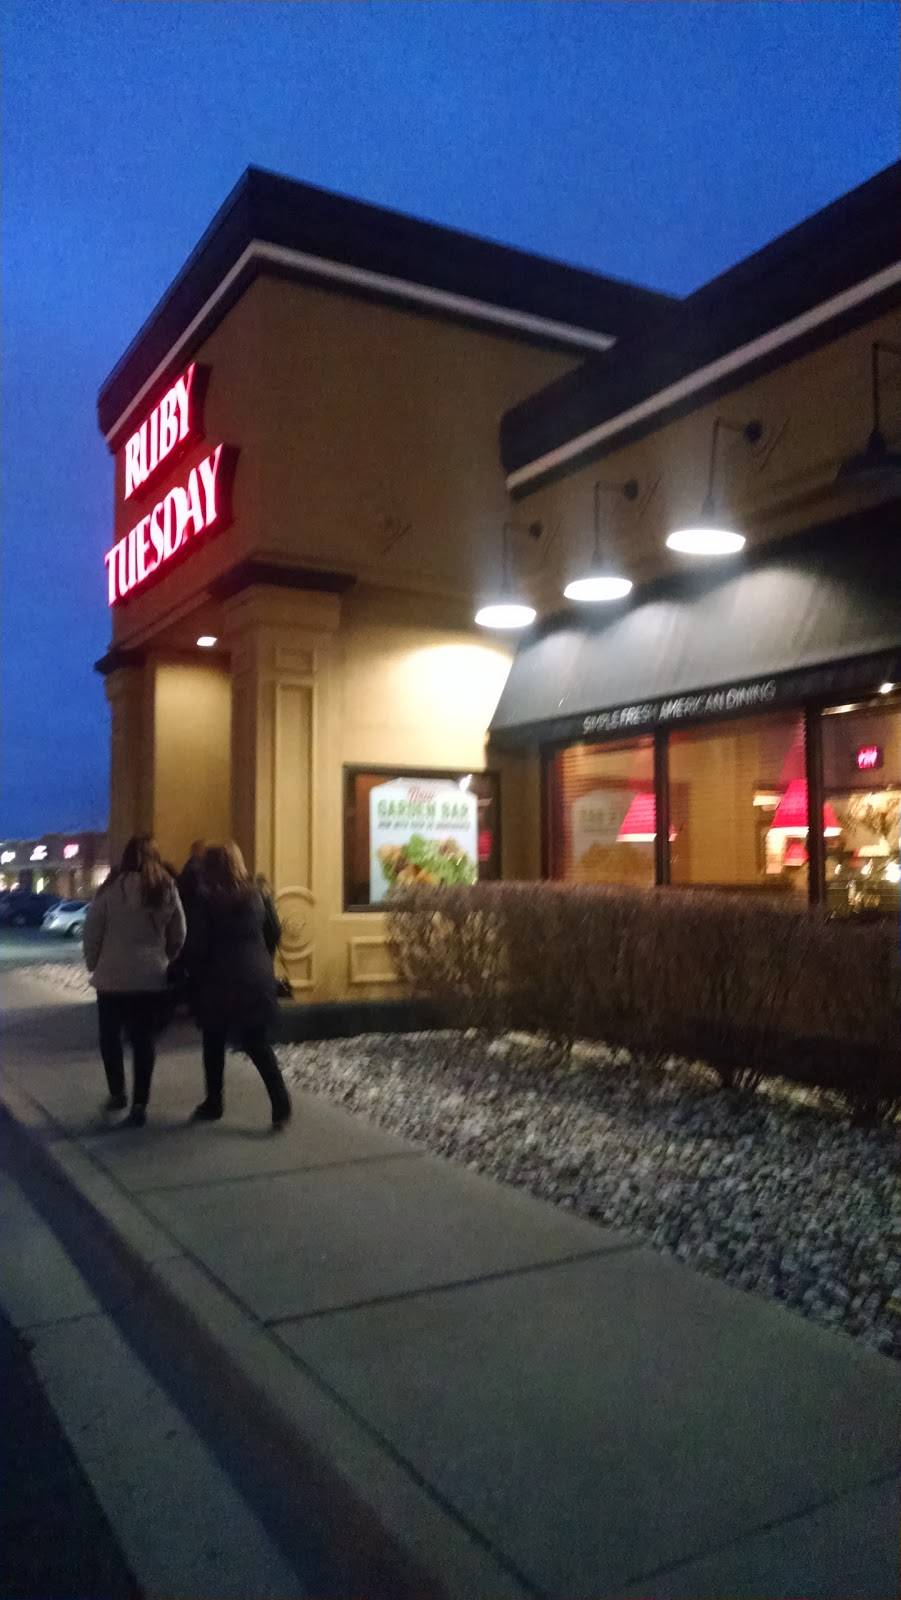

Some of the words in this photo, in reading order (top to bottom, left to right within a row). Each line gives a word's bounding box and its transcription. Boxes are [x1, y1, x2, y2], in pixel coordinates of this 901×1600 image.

[124, 362, 195, 500] RUBY
[104, 442, 223, 608] TUESDAY
[658, 692, 725, 720] AMERICAN
[725, 680, 776, 709] DINING
[377, 800, 436, 818] GARDEN
